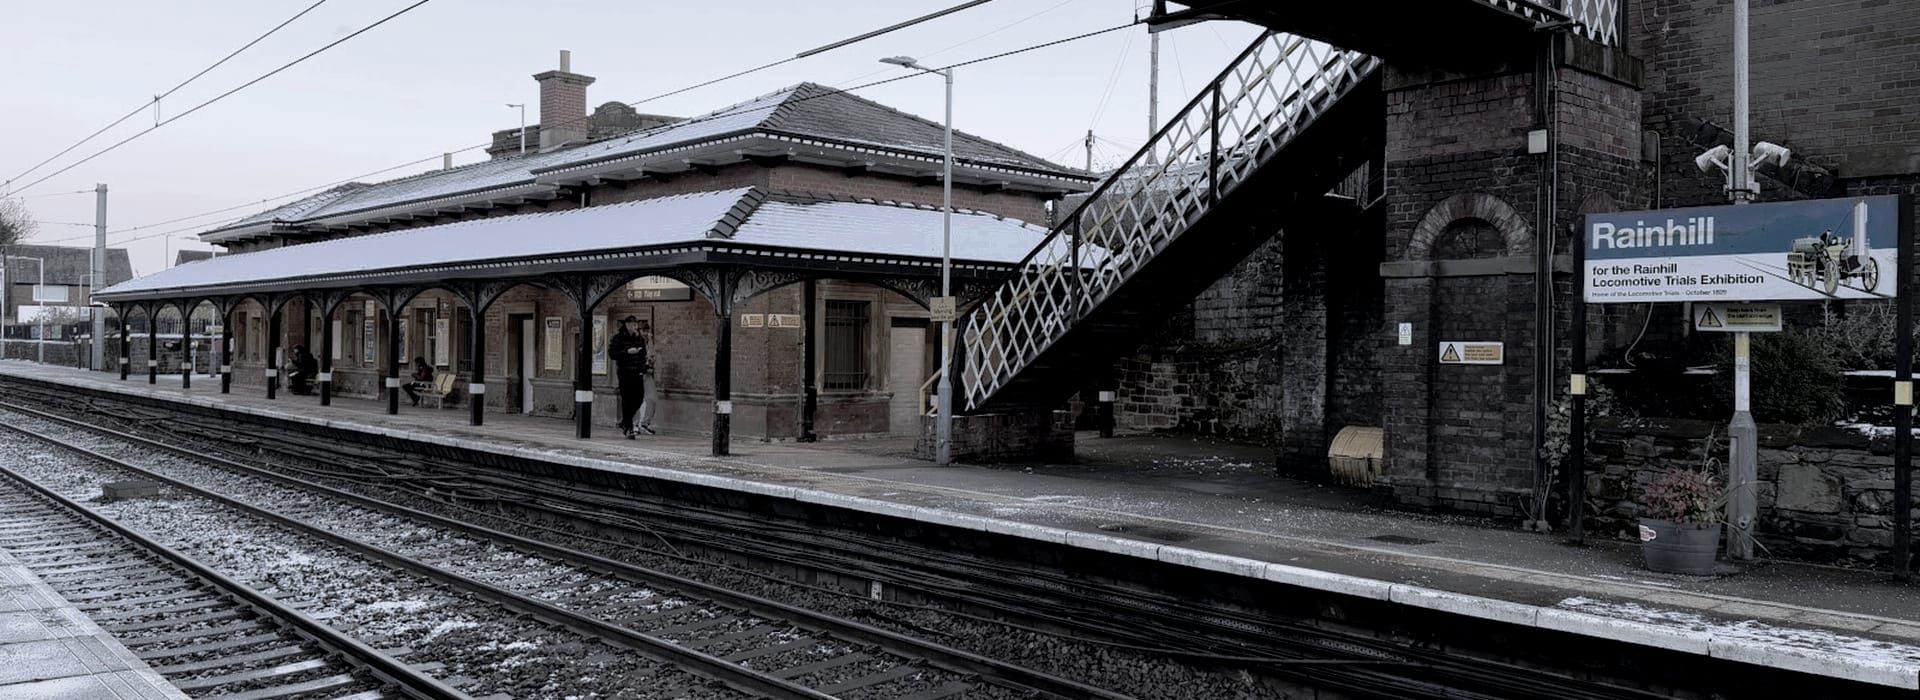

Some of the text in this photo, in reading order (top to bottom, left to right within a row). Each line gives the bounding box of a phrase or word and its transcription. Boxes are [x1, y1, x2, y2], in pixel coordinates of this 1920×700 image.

[1592, 216, 1714, 250] Rainhill
[1592, 263, 1678, 276] for the Rainhill
[1592, 273, 1764, 288] Locomotive Trials Exhibition
